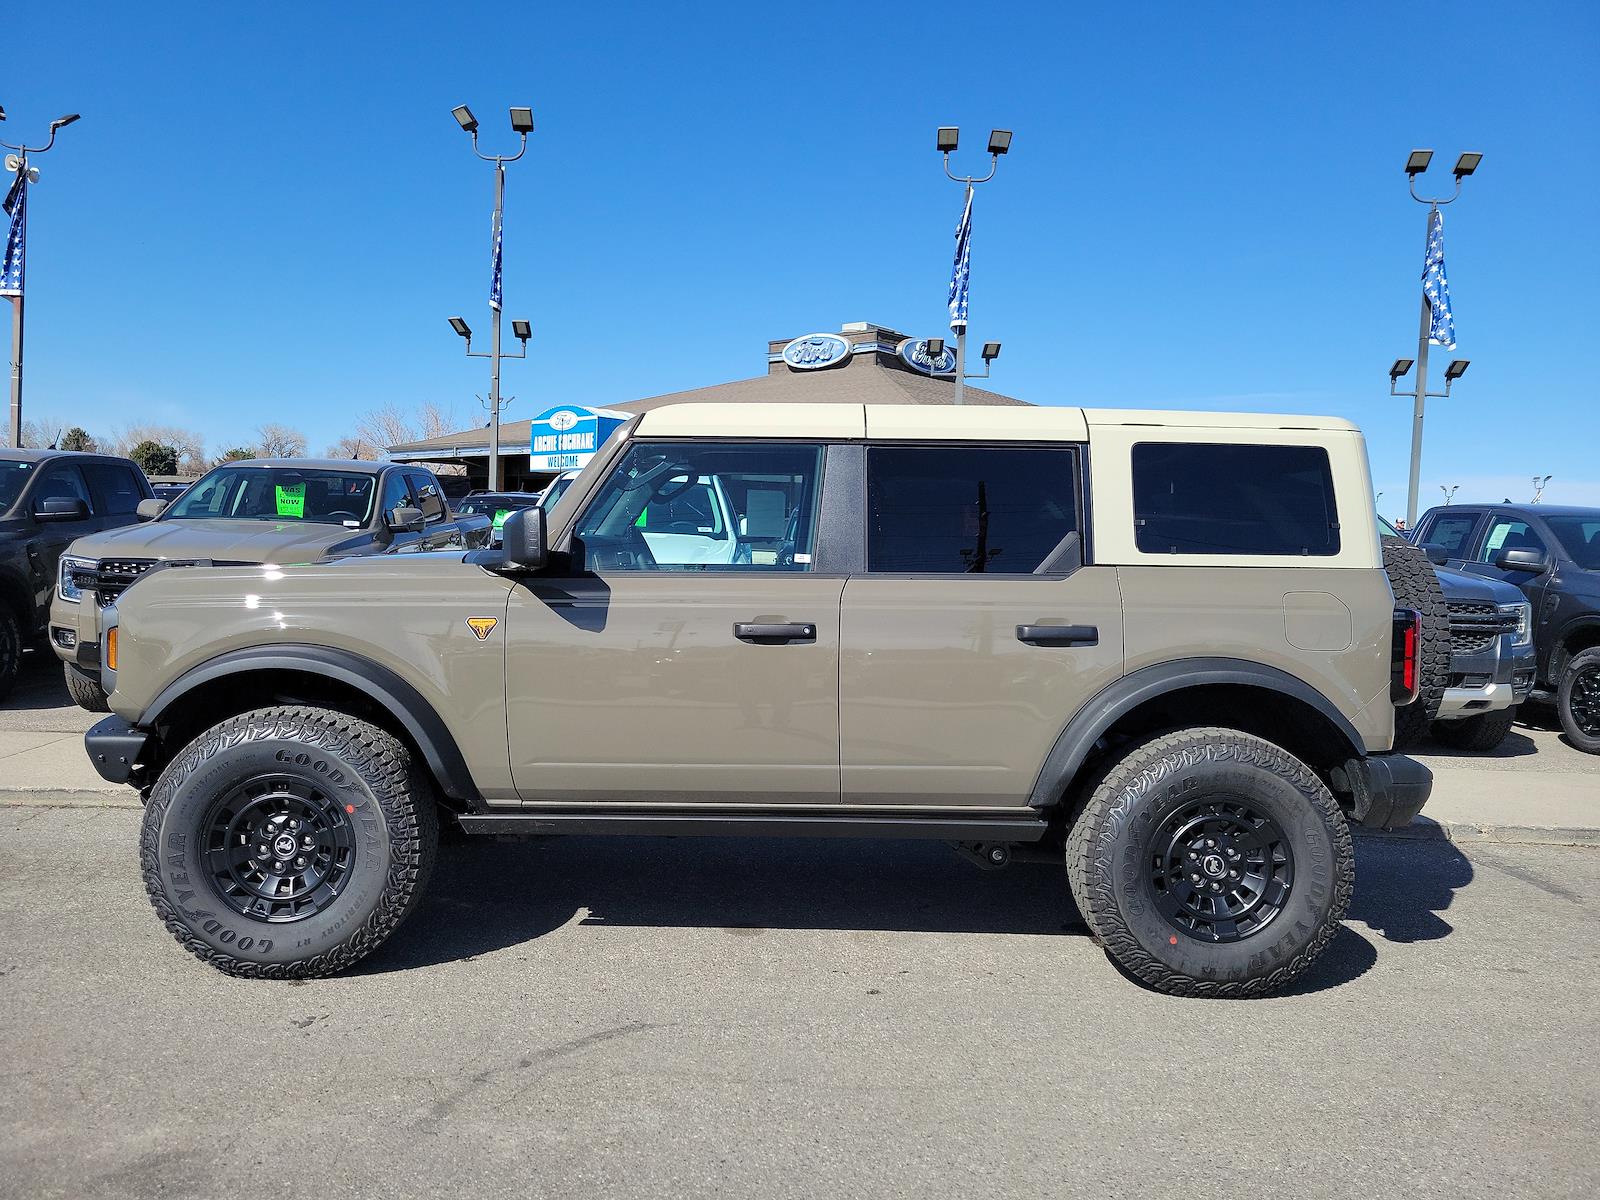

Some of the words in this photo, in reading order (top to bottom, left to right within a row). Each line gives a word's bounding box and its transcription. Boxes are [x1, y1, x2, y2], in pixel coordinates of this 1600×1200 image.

[792, 339, 834, 363] Ford
[533, 435, 557, 452] ARCHIE
[558, 432, 594, 451] COCHRANE
[547, 455, 578, 468] WELCOME
